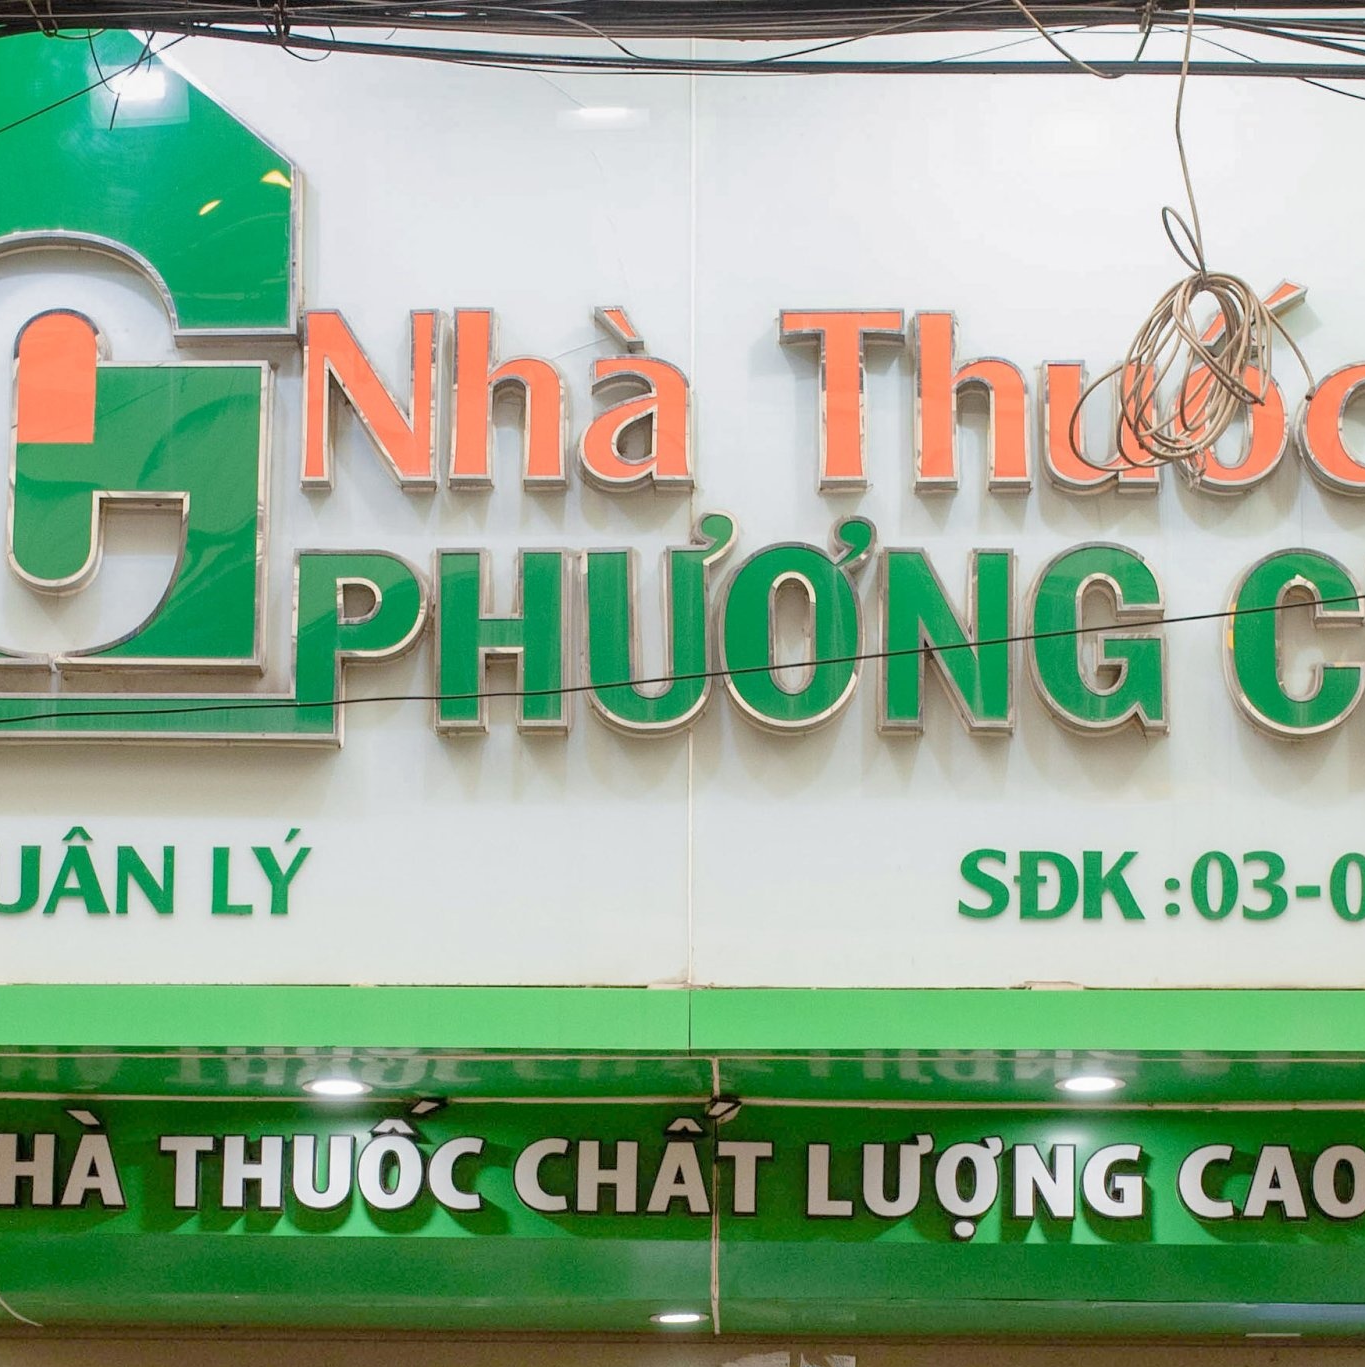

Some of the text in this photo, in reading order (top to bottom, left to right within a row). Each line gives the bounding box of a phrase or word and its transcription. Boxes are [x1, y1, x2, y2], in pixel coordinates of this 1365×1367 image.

[301, 306, 694, 493] Nhà
[293, 510, 1170, 742] PHƯƠNG
[211, 828, 313, 915] LÝ
[160, 1099, 486, 1213] THUỐC
[512, 1100, 775, 1218] CHẤT
[806, 1133, 1145, 1242] LƯỢNG
